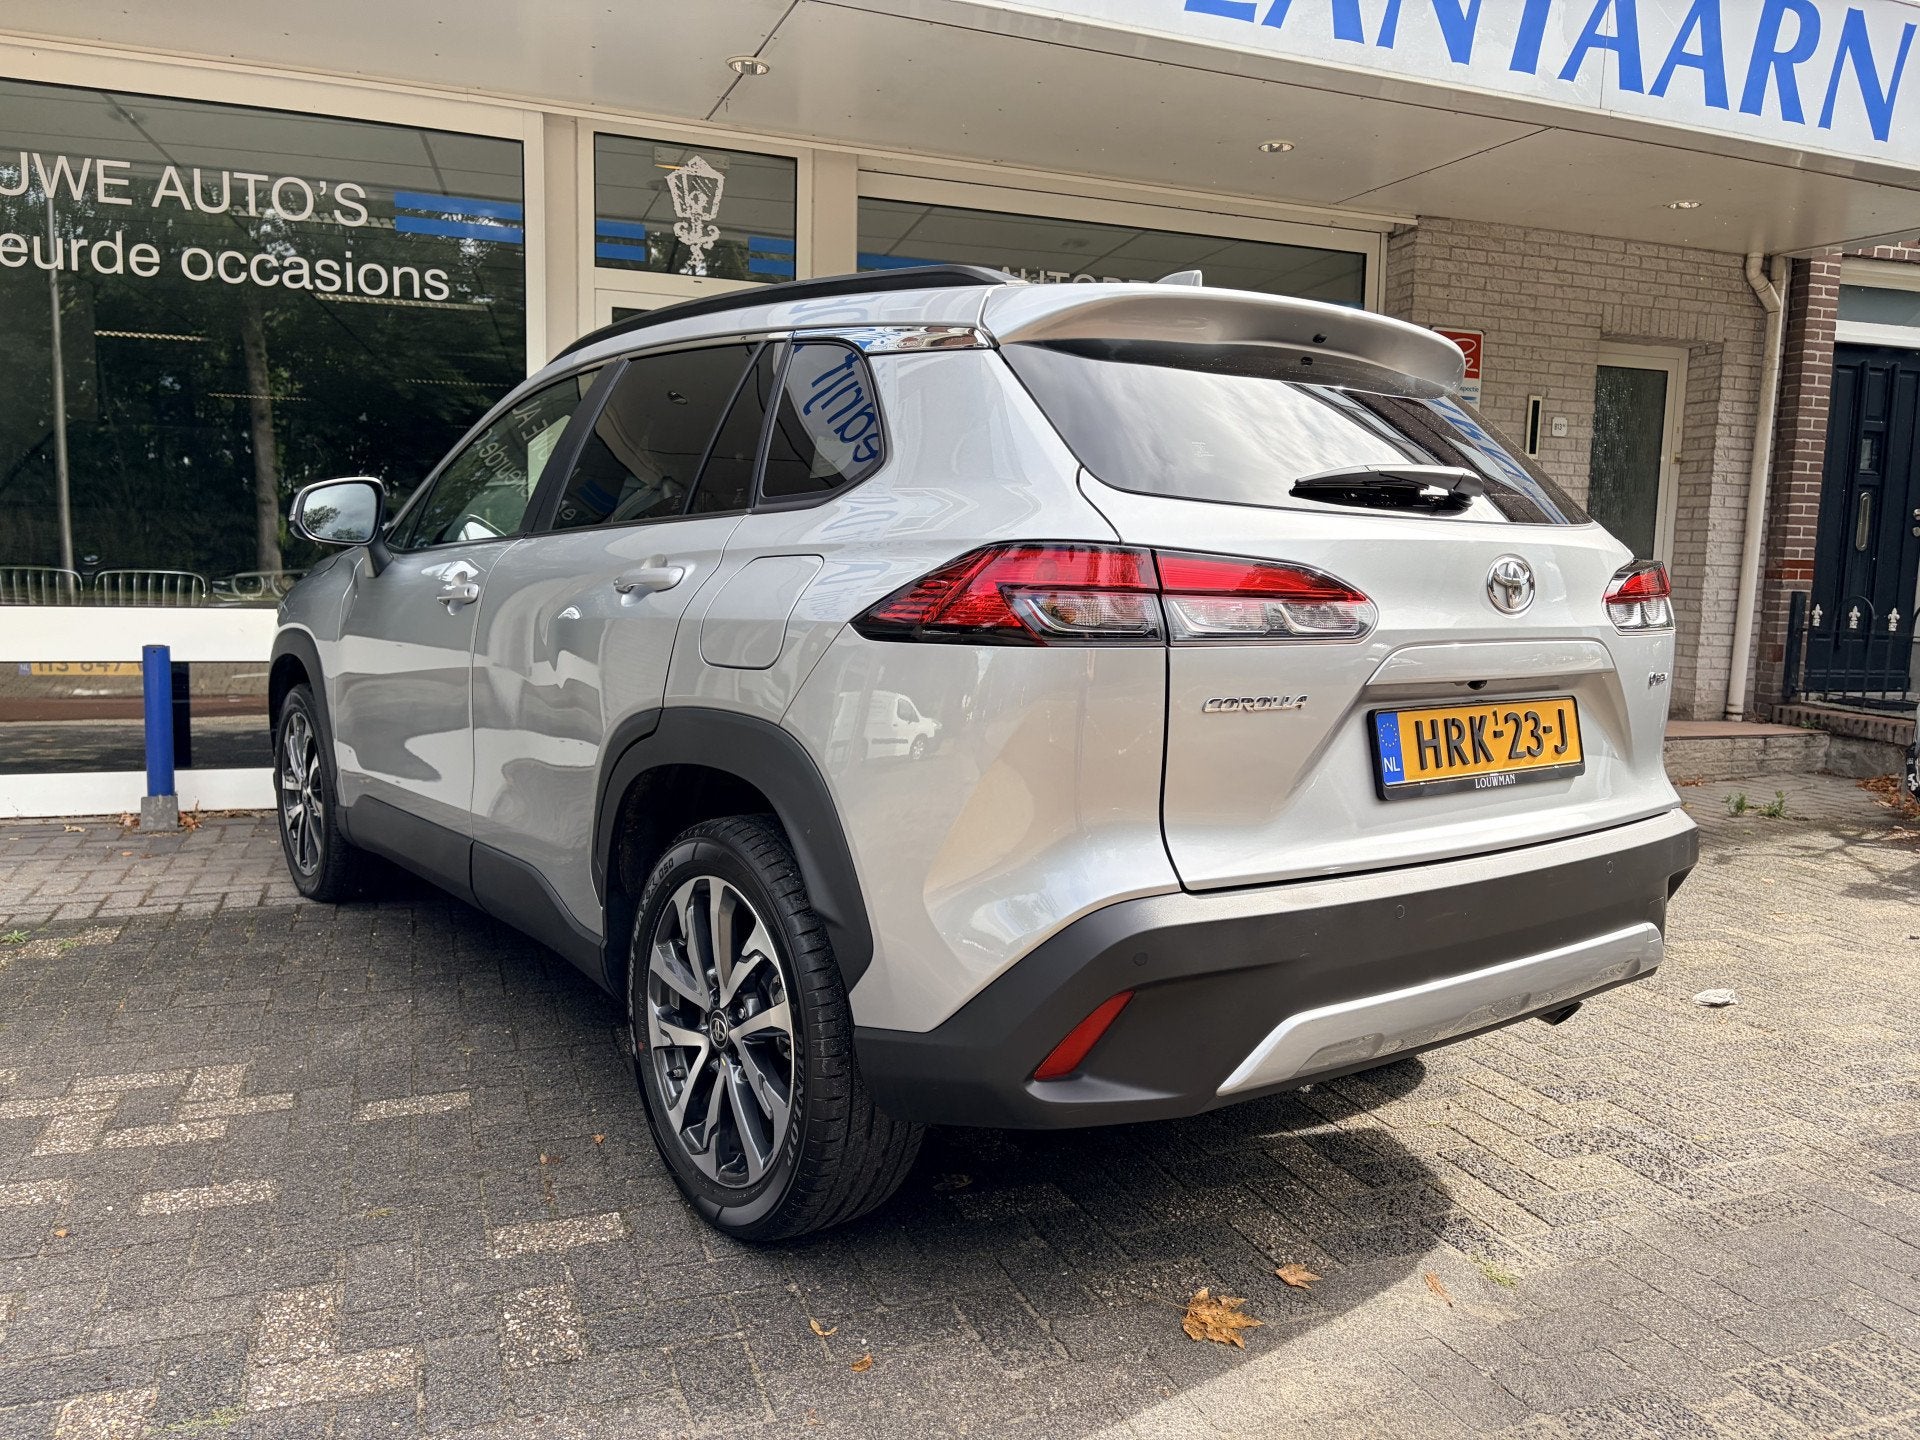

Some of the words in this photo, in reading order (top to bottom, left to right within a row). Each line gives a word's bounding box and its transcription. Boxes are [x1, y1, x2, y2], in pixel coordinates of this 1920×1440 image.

[1184, 0, 1918, 142] NTAARN
[0, 150, 132, 206] UWE
[151, 165, 369, 228] AUTO'S
[0, 230, 161, 277] eurde
[180, 247, 450, 302] occasions
[1201, 694, 1309, 714] COROLLA
[1384, 757, 1401, 773] NL
[1474, 773, 1517, 790] LOUWMAN
